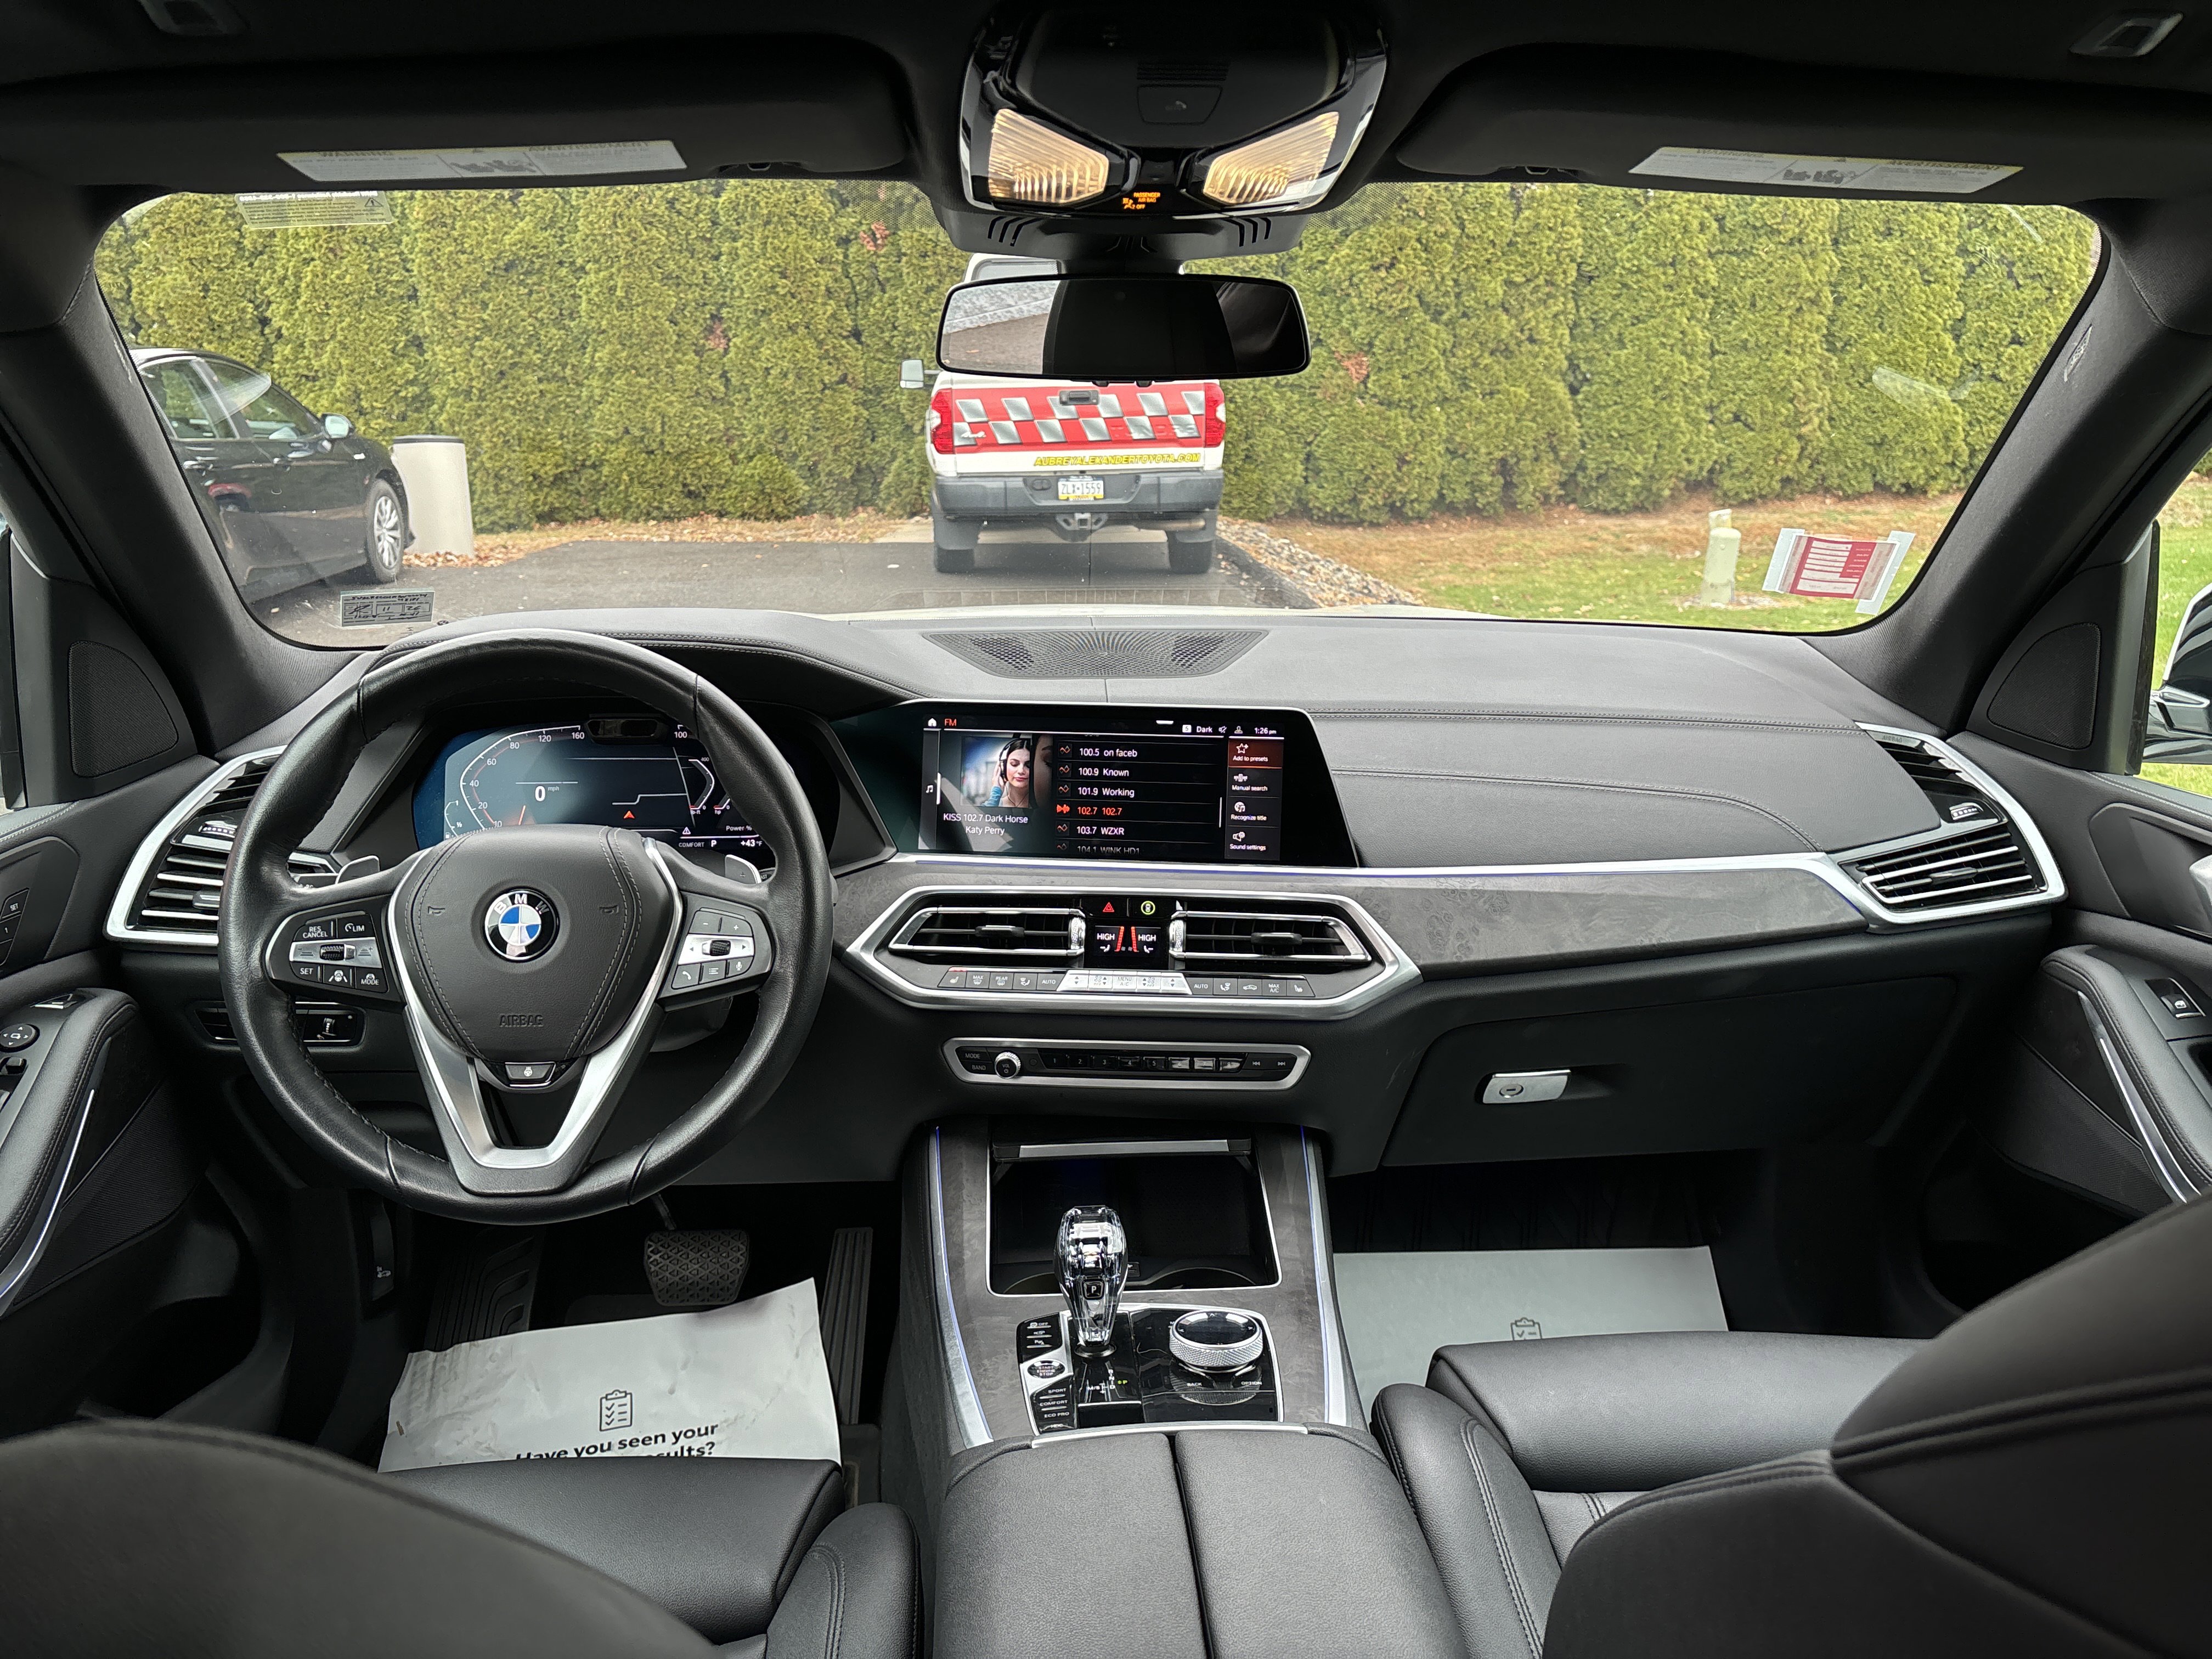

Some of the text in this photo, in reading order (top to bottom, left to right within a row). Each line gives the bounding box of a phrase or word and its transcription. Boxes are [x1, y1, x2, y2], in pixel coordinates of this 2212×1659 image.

[1079, 748, 1099, 757] 100.5
[1116, 749, 1137, 757] faceb
[1078, 768, 1129, 776] 100.9 Known
[535, 786, 545, 802] 0
[1077, 787, 1135, 798] 101.9 Working
[1077, 806, 1122, 816] 102.7 102.7
[944, 813, 961, 821] KISS
[964, 814, 983, 822] 102.7
[985, 814, 1003, 822] Dark
[966, 826, 1005, 836] Katy Perry
[1076, 826, 1097, 834] 103.7
[1100, 846, 1122, 854] WINK
[494, 893, 550, 915] BMW
[499, 1014, 544, 1028] AIRBAG
[573, 1441, 612, 1457] you
[618, 1434, 666, 1450] seen
[671, 1424, 719, 1445] your
